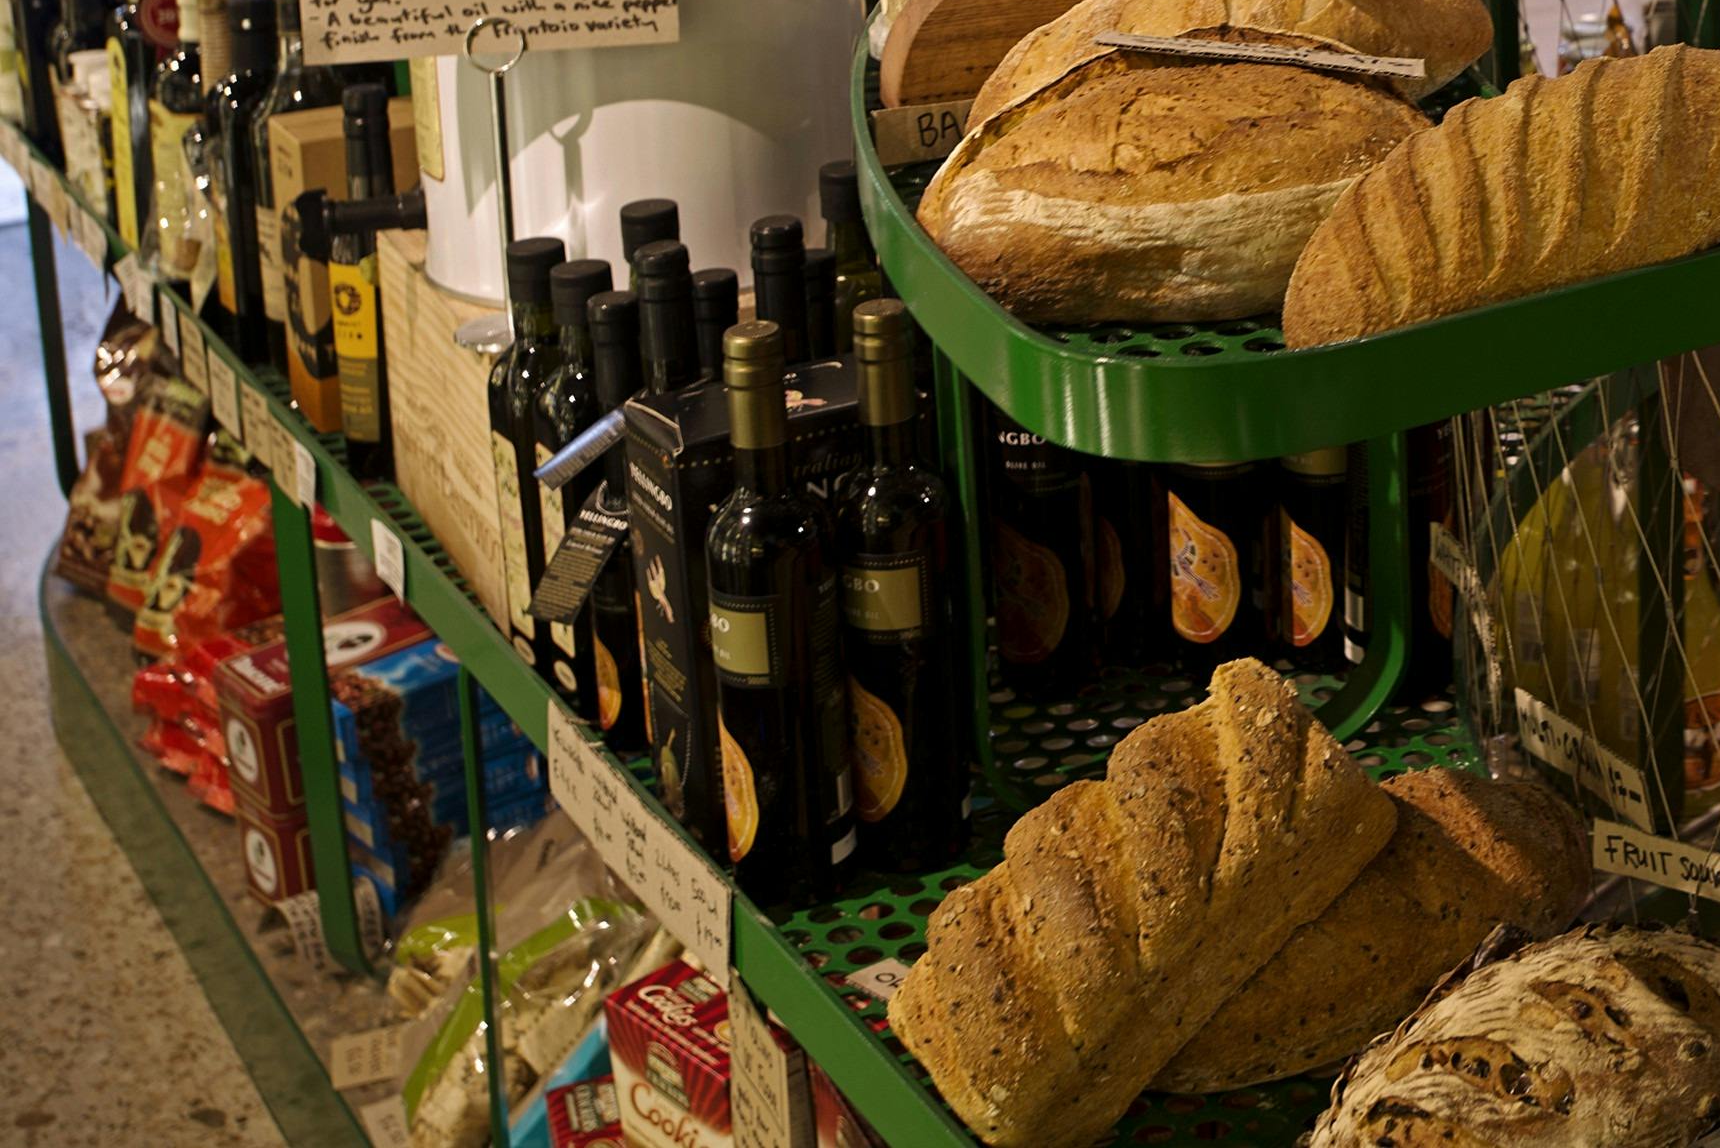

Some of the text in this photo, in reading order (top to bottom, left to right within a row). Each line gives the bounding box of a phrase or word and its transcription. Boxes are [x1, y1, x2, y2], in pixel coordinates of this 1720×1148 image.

[320, 31, 381, 51] finish
[397, 27, 437, 45] from
[583, 15, 660, 36] variety
[326, 11, 343, 29] A
[348, 4, 455, 27] beautiful
[461, 1, 490, 19] oil
[552, 1, 568, 10] a
[1603, 834, 1673, 876] FRUIT
